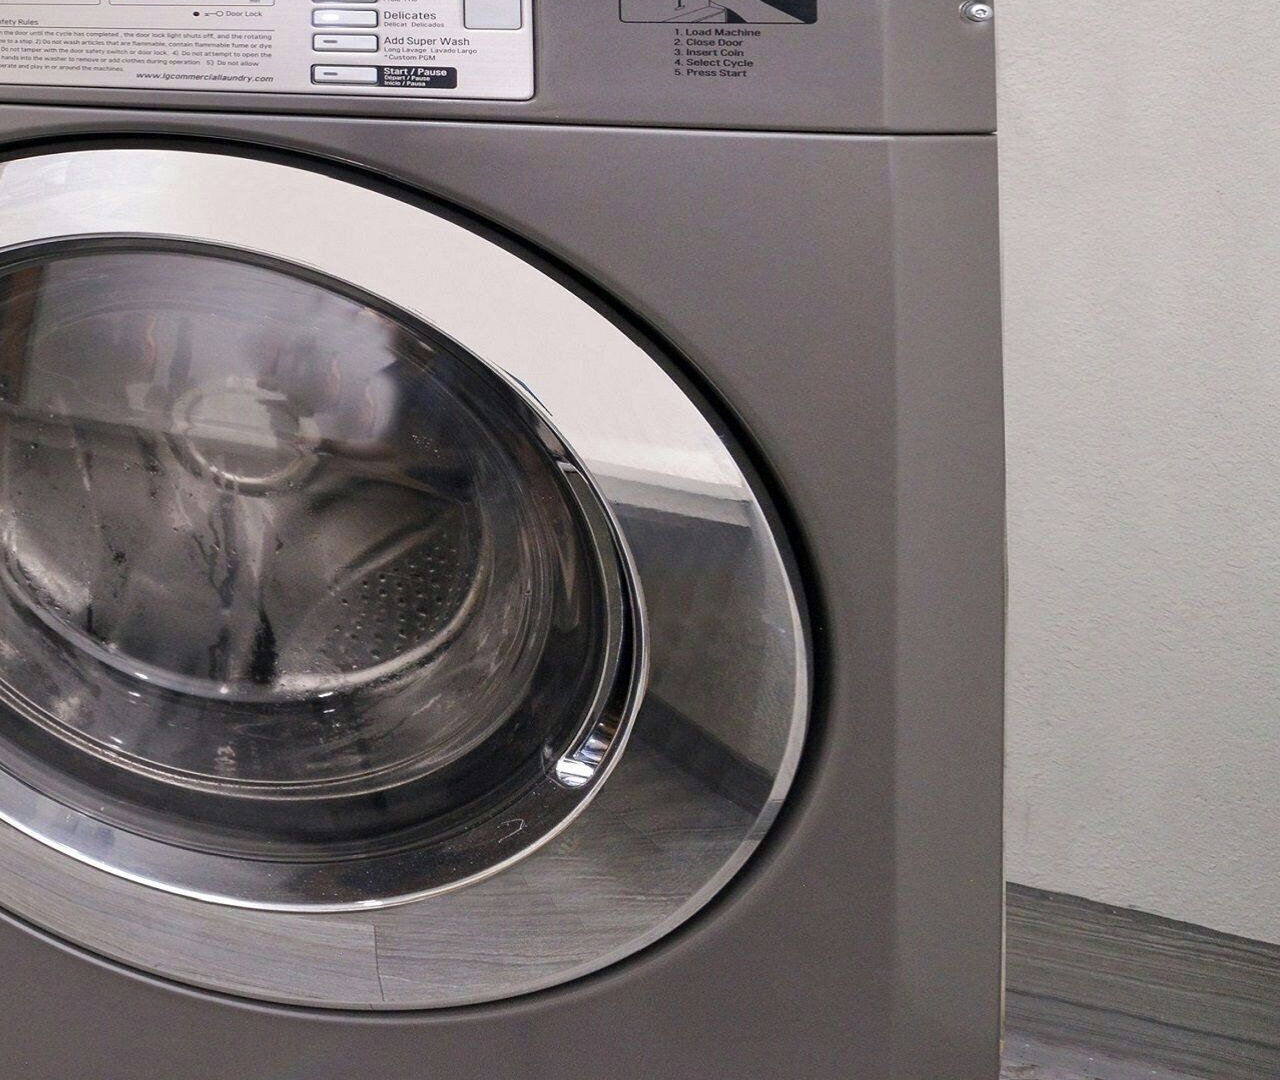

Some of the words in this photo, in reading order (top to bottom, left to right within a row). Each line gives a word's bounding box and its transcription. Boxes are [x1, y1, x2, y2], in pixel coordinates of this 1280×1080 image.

[383, 11, 437, 20] Delicates
[383, 37, 405, 45] Add
[406, 37, 437, 46] Super
[439, 37, 470, 46] Wash
[674, 39, 683, 47] 2.
[686, 39, 715, 47] Close
[718, 39, 744, 47] Door
[674, 59, 683, 67] 4.
[686, 59, 720, 67] Select
[722, 59, 753, 68] Cycle
[384, 68, 408, 76] Start
[417, 68, 447, 77] Pause
[674, 69, 683, 77] 5.
[686, 69, 716, 77] Press
[719, 69, 748, 77] Start
[136, 72, 274, 83] www.lgcommerciallaundry.com
